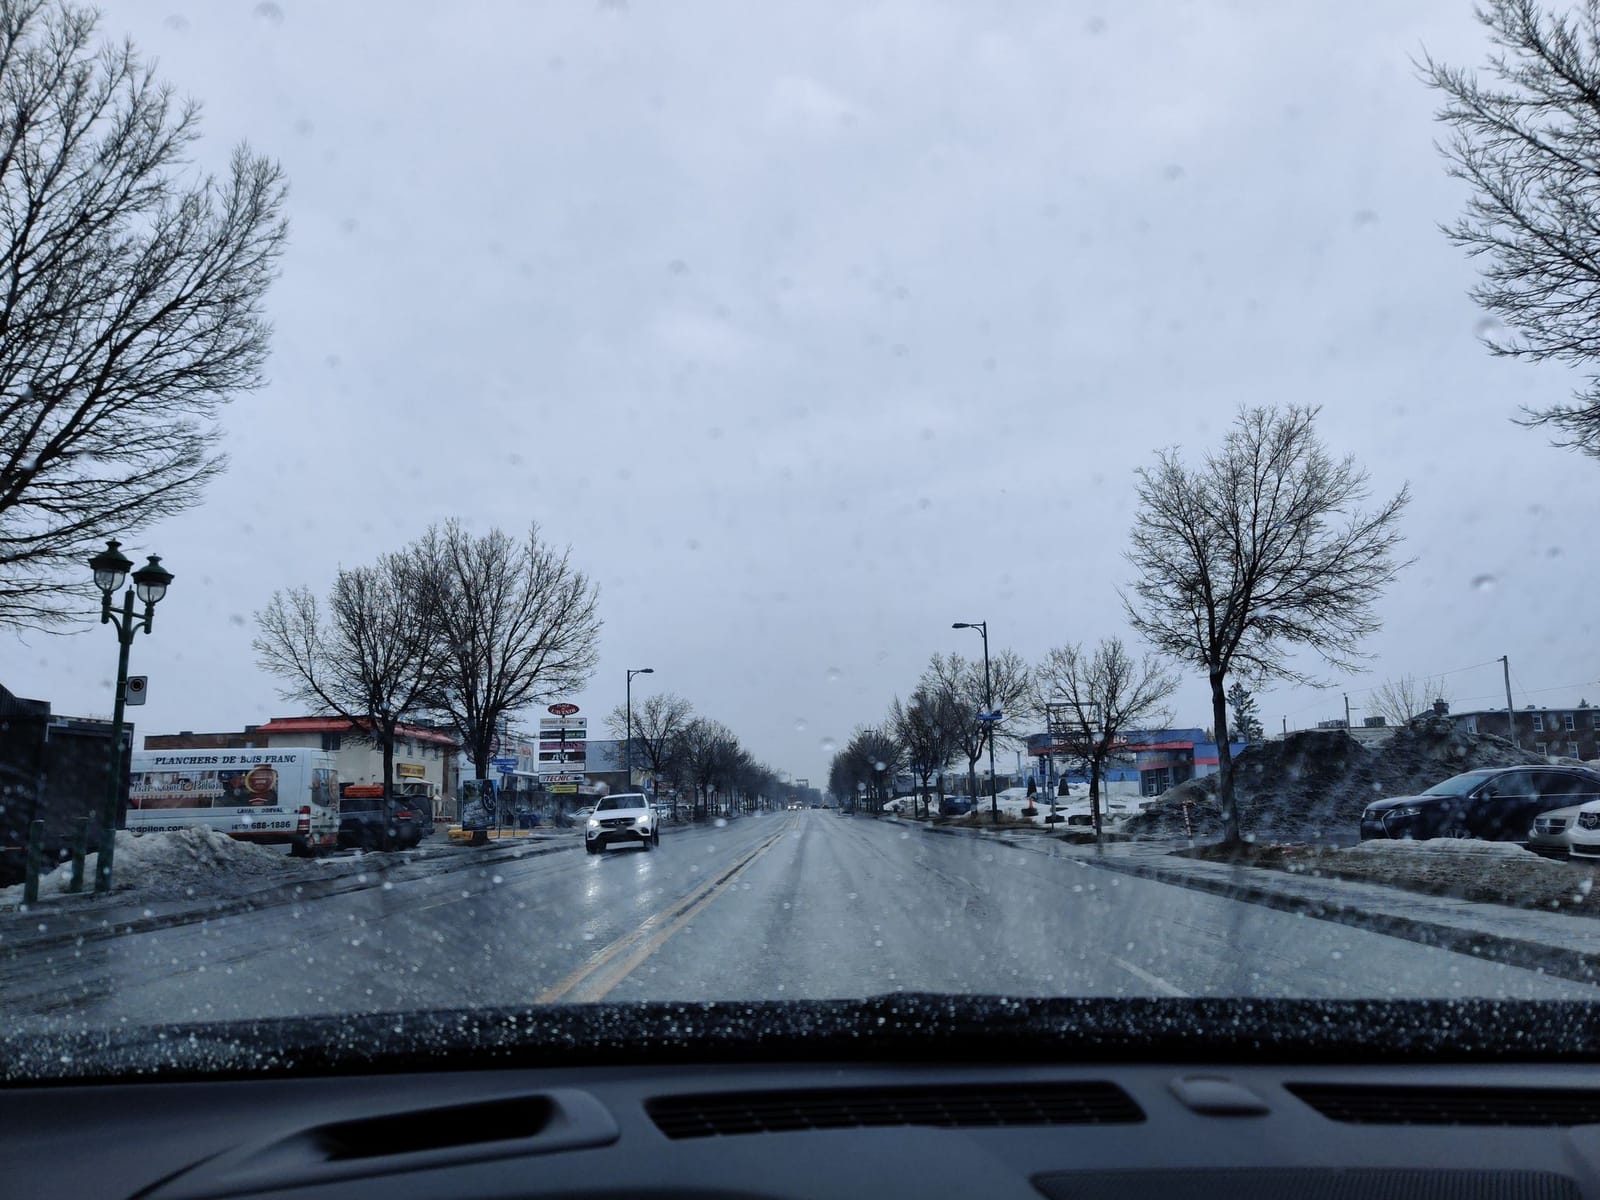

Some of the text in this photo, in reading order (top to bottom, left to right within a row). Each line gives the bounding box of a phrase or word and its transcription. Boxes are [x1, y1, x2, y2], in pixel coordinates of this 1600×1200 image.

[155, 754, 297, 765] PLANCHERS DE BOIS FRANC
